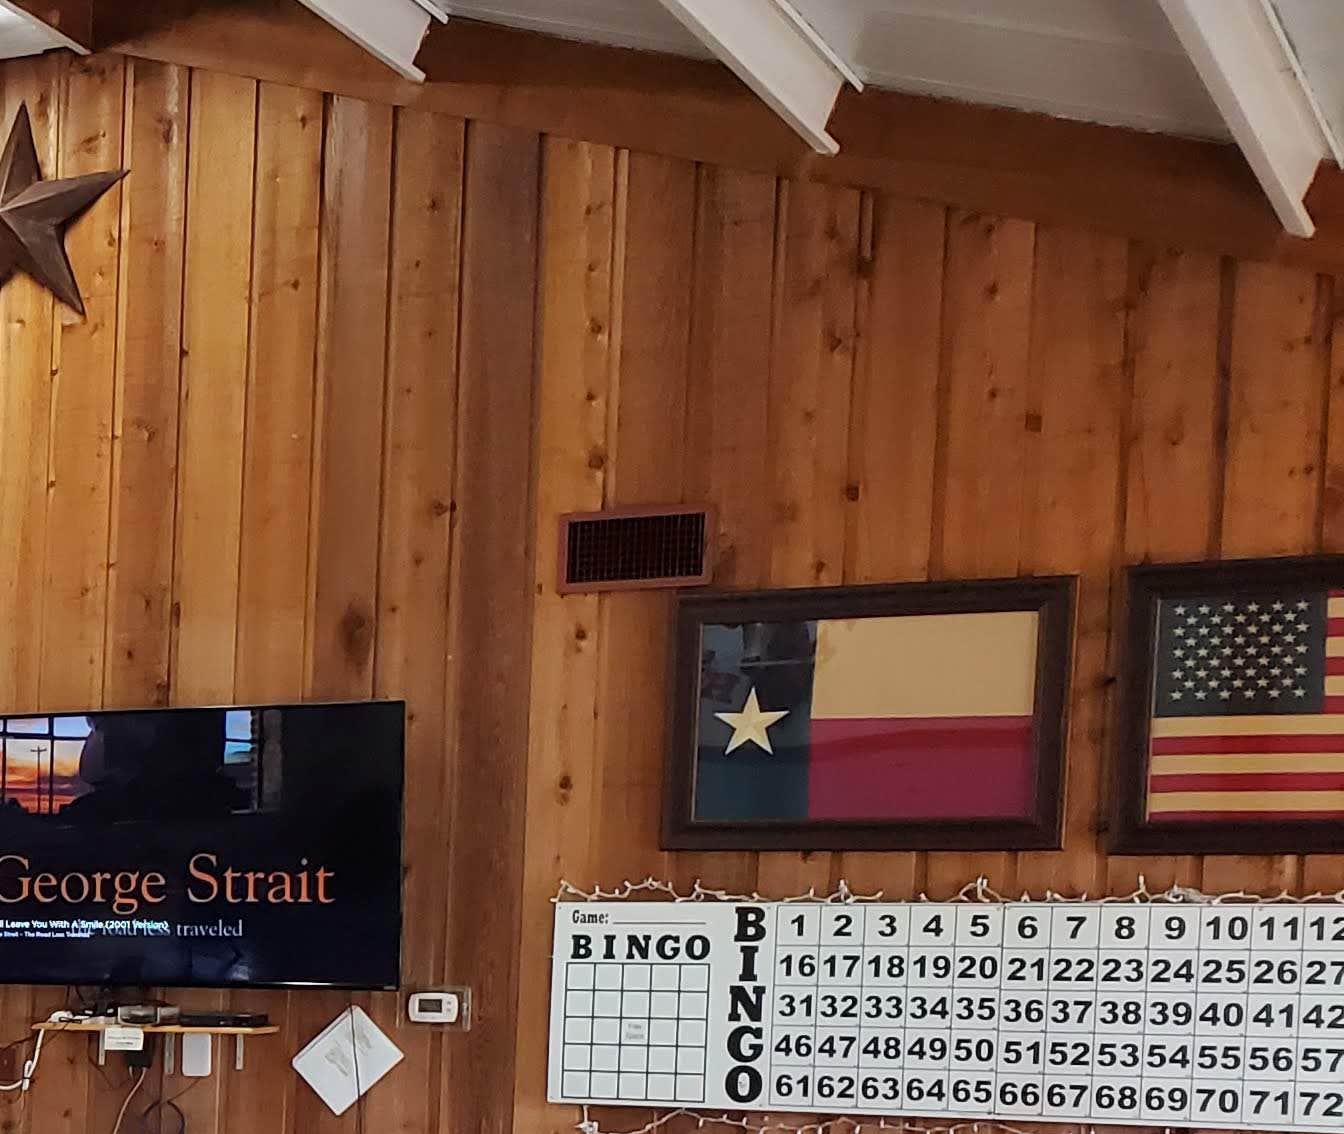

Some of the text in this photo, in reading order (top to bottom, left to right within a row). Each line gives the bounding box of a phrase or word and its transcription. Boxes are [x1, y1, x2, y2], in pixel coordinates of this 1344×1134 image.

[187, 853, 334, 904] Strait
[176, 919, 243, 937] traveled
[571, 909, 609, 925] Game:
[790, 914, 1344, 941] 1 2 3 4 5 6 7 8 9 10 11 12
[779, 954, 1344, 985] 16 17 18 19 20 21 22 23 24 25 26 27
[778, 994, 1344, 1029] 31 32 33 34 35 36 37 38 39 40 41 42
[774, 1034, 1344, 1073] 46 47 48 49 50 51 52 53 54 55 56 57
[775, 1074, 1344, 1117] 61 62 63 64 65 66 67 68 69 70 71 72
